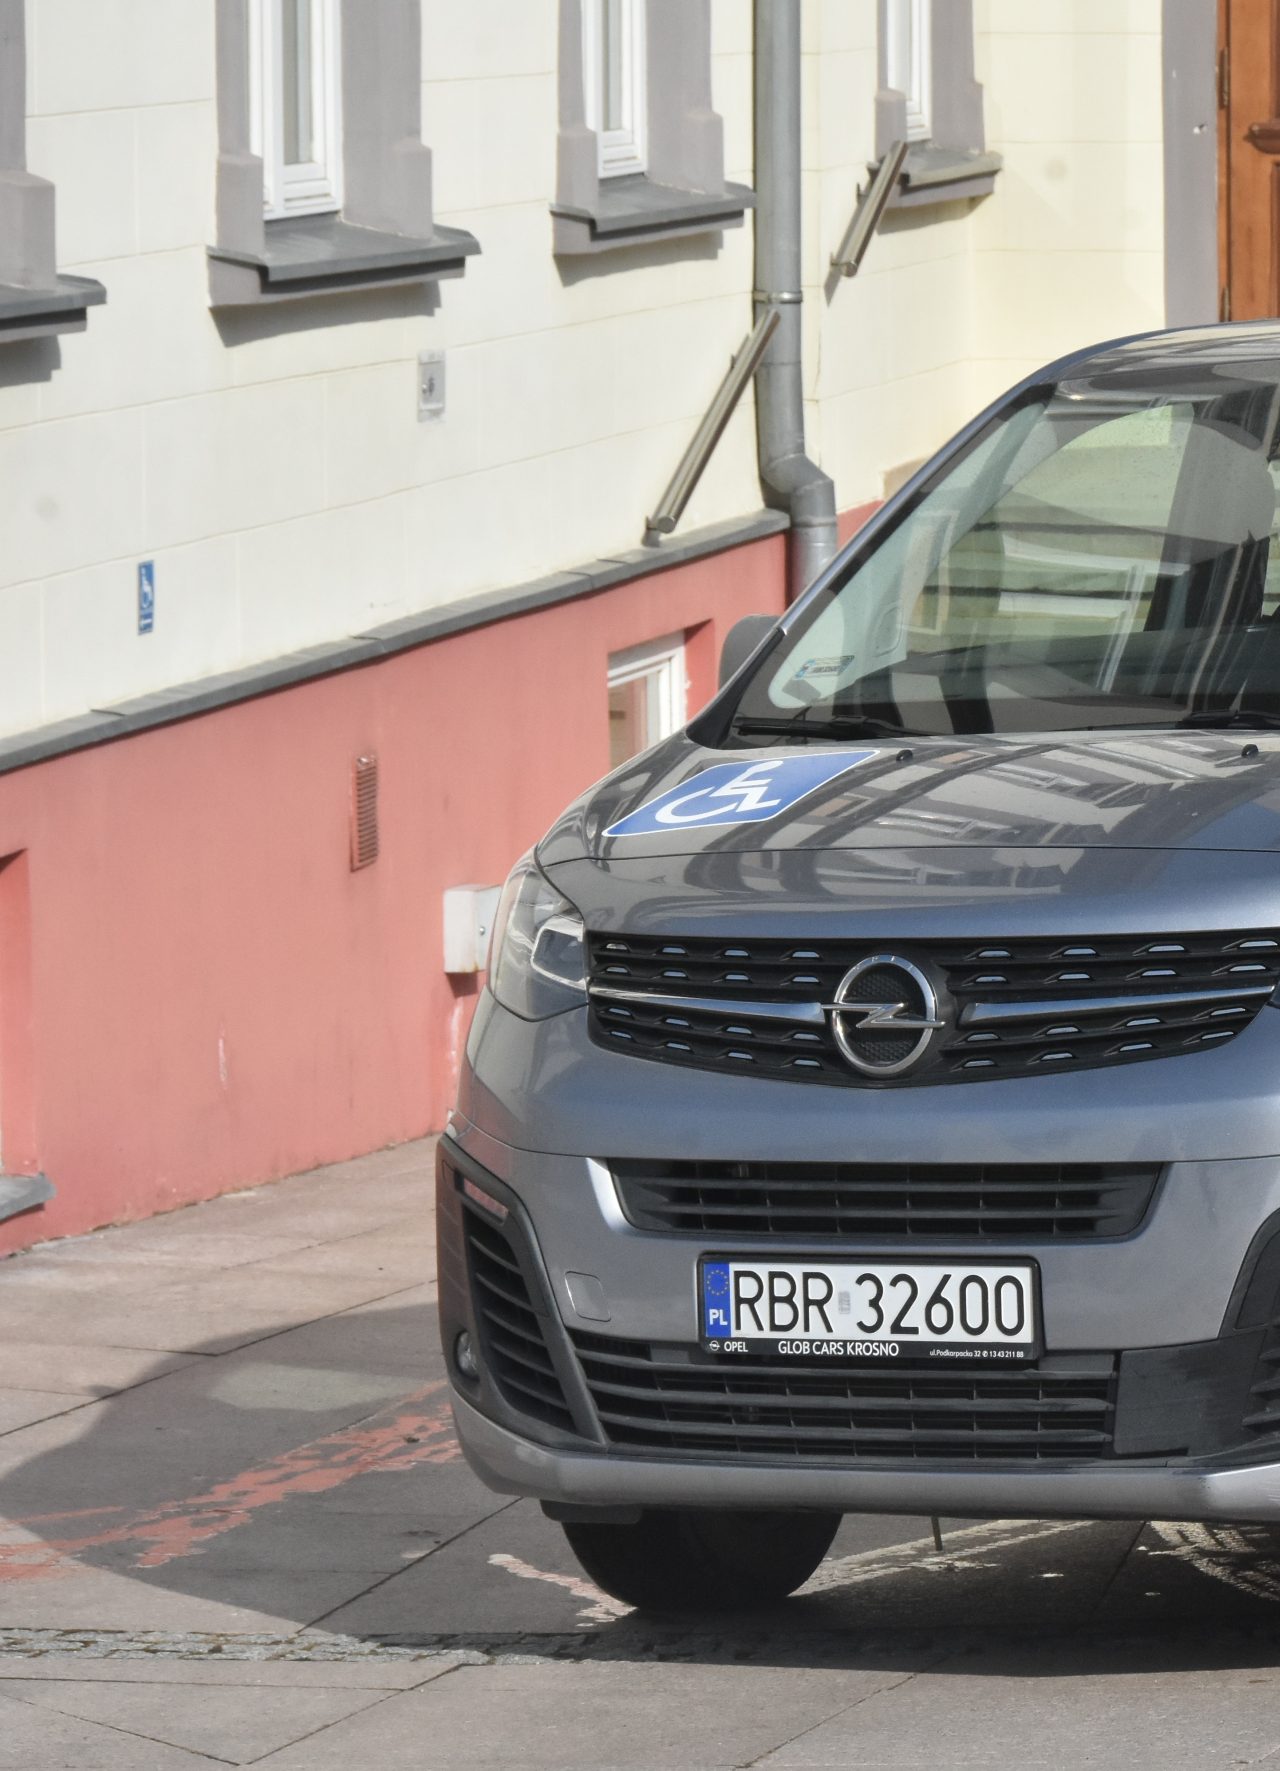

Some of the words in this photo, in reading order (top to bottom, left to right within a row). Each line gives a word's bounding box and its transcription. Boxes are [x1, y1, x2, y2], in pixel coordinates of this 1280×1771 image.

[734, 1271, 833, 1332] RBR
[855, 1273, 1025, 1336] 32600
[709, 1309, 728, 1325] PL
[724, 1341, 748, 1353] OPEL
[778, 1341, 810, 1354] GLOB
[813, 1341, 844, 1355] CARS
[847, 1342, 899, 1357] KROSNO
